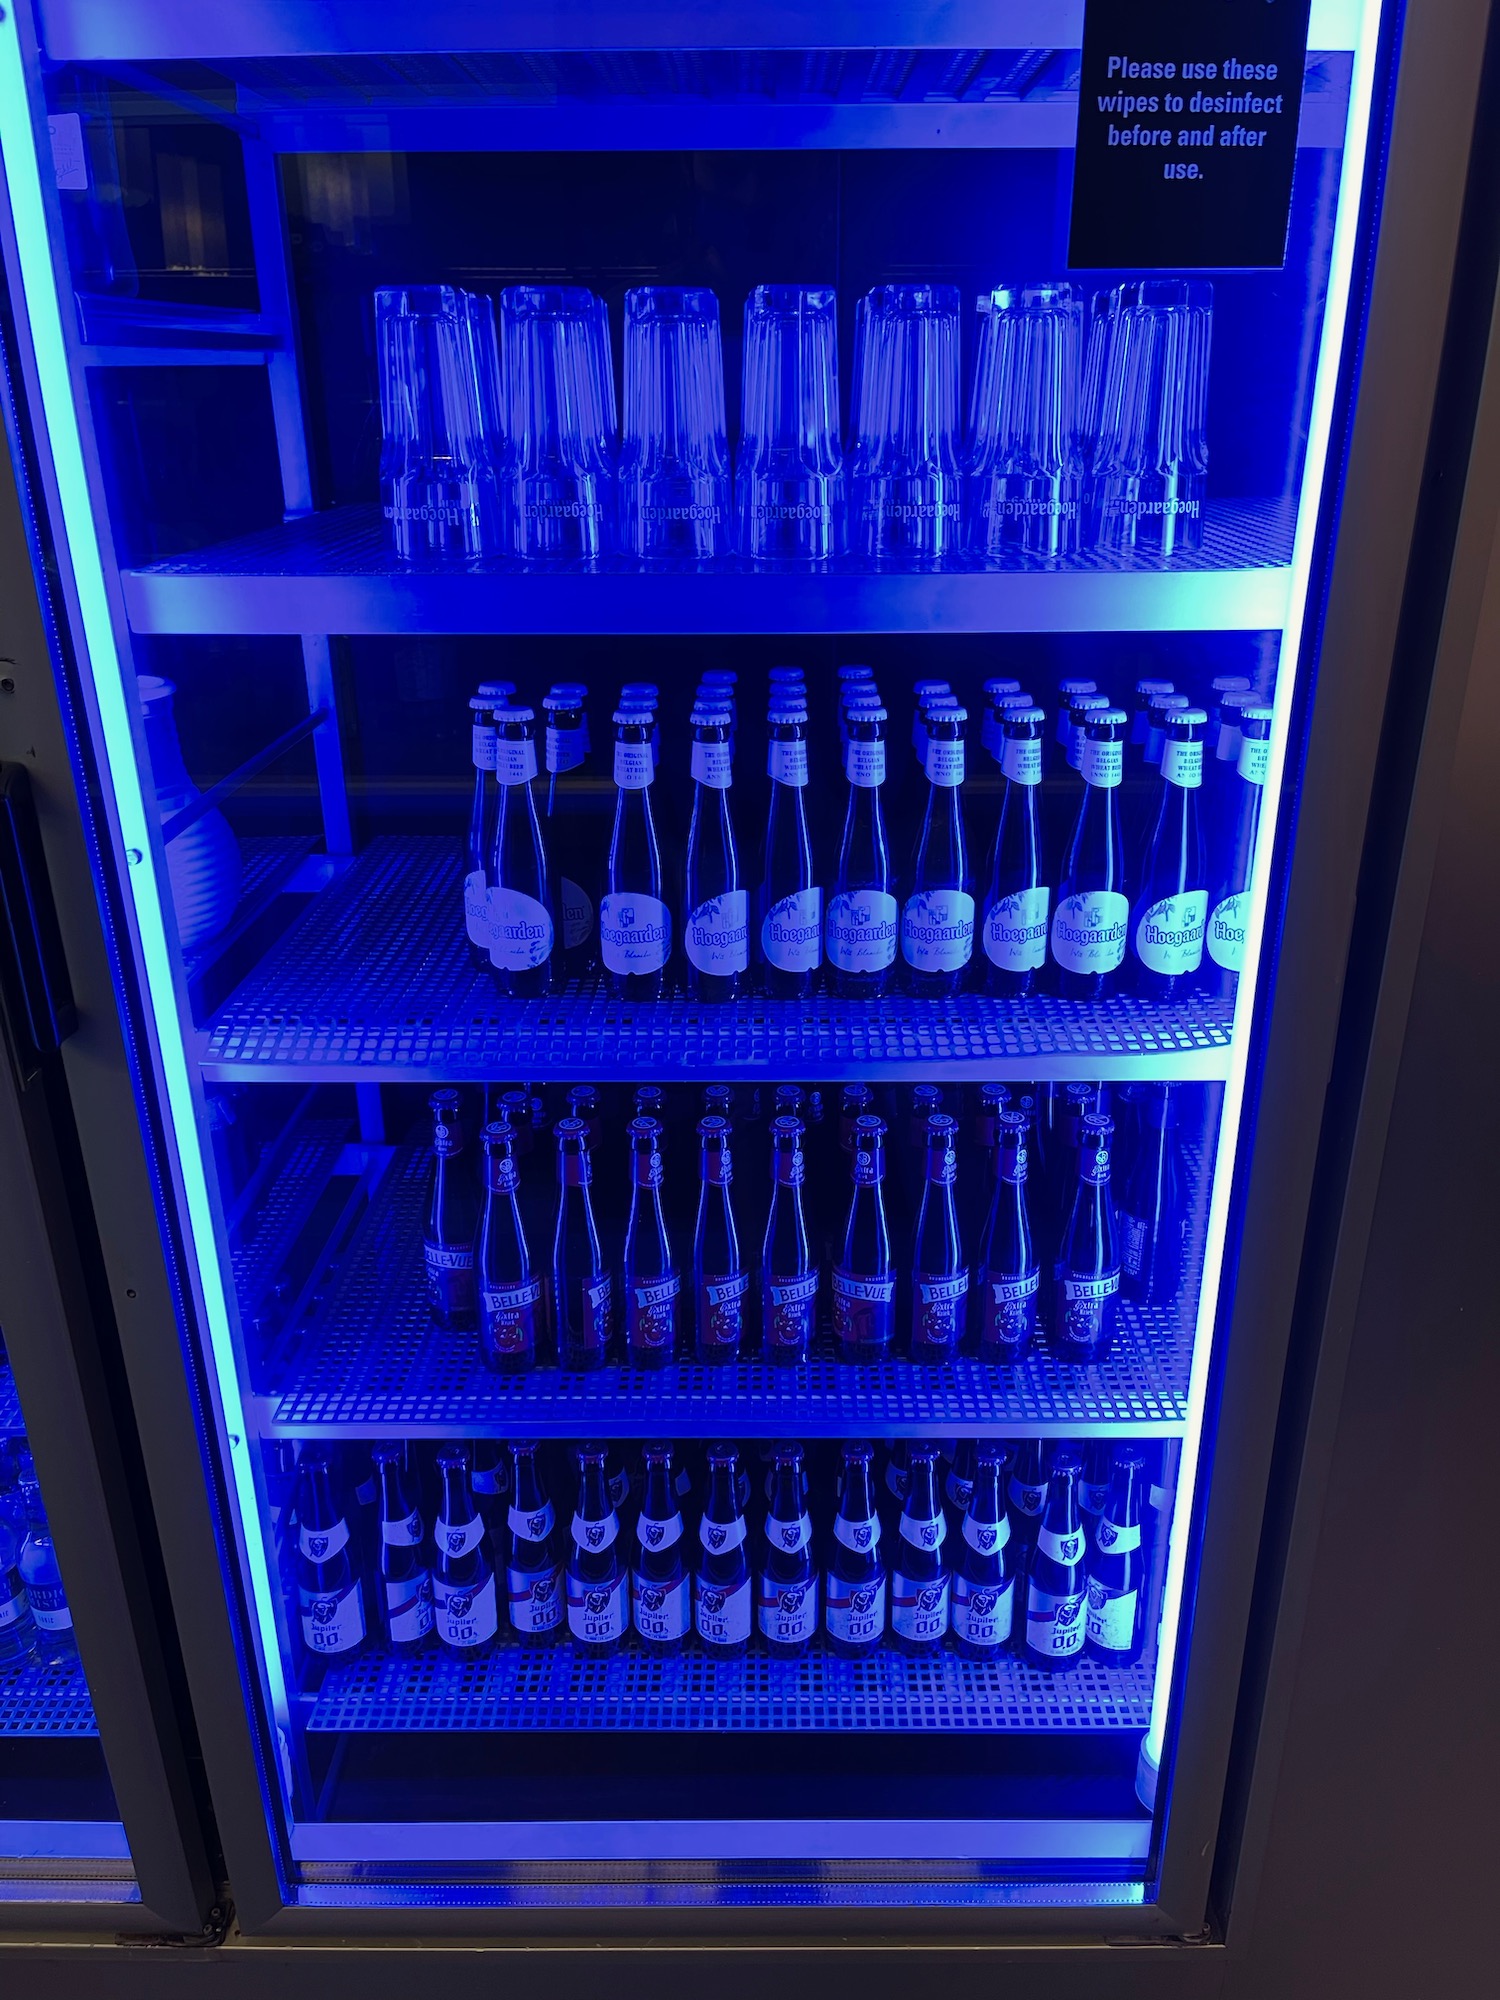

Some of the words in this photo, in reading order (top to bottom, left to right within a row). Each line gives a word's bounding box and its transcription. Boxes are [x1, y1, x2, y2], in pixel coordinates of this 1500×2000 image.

[1107, 55, 1176, 79] Please
[1181, 62, 1218, 79] use
[1223, 57, 1278, 80] these
[1097, 90, 1160, 118] wipes
[1164, 92, 1184, 112] to
[1189, 90, 1283, 114] desinfect
[1107, 124, 1172, 146] before
[1178, 124, 1215, 146] and
[1220, 125, 1267, 147] after
[1163, 163, 1204, 180] use.
[1119, 498, 1200, 520] Hoegaarden
[1214, 920, 1245, 944] Hoe
[1073, 1300, 1099, 1312] Extra
[583, 1612, 614, 1622] Jupiler
[775, 1612, 807, 1622] Jupiler
[847, 1611, 878, 1622] Jupiler
[914, 1609, 944, 1620] Jupiler
[966, 1613, 998, 1623] Jupiler
[1051, 1623, 1081, 1635] Jupiler
